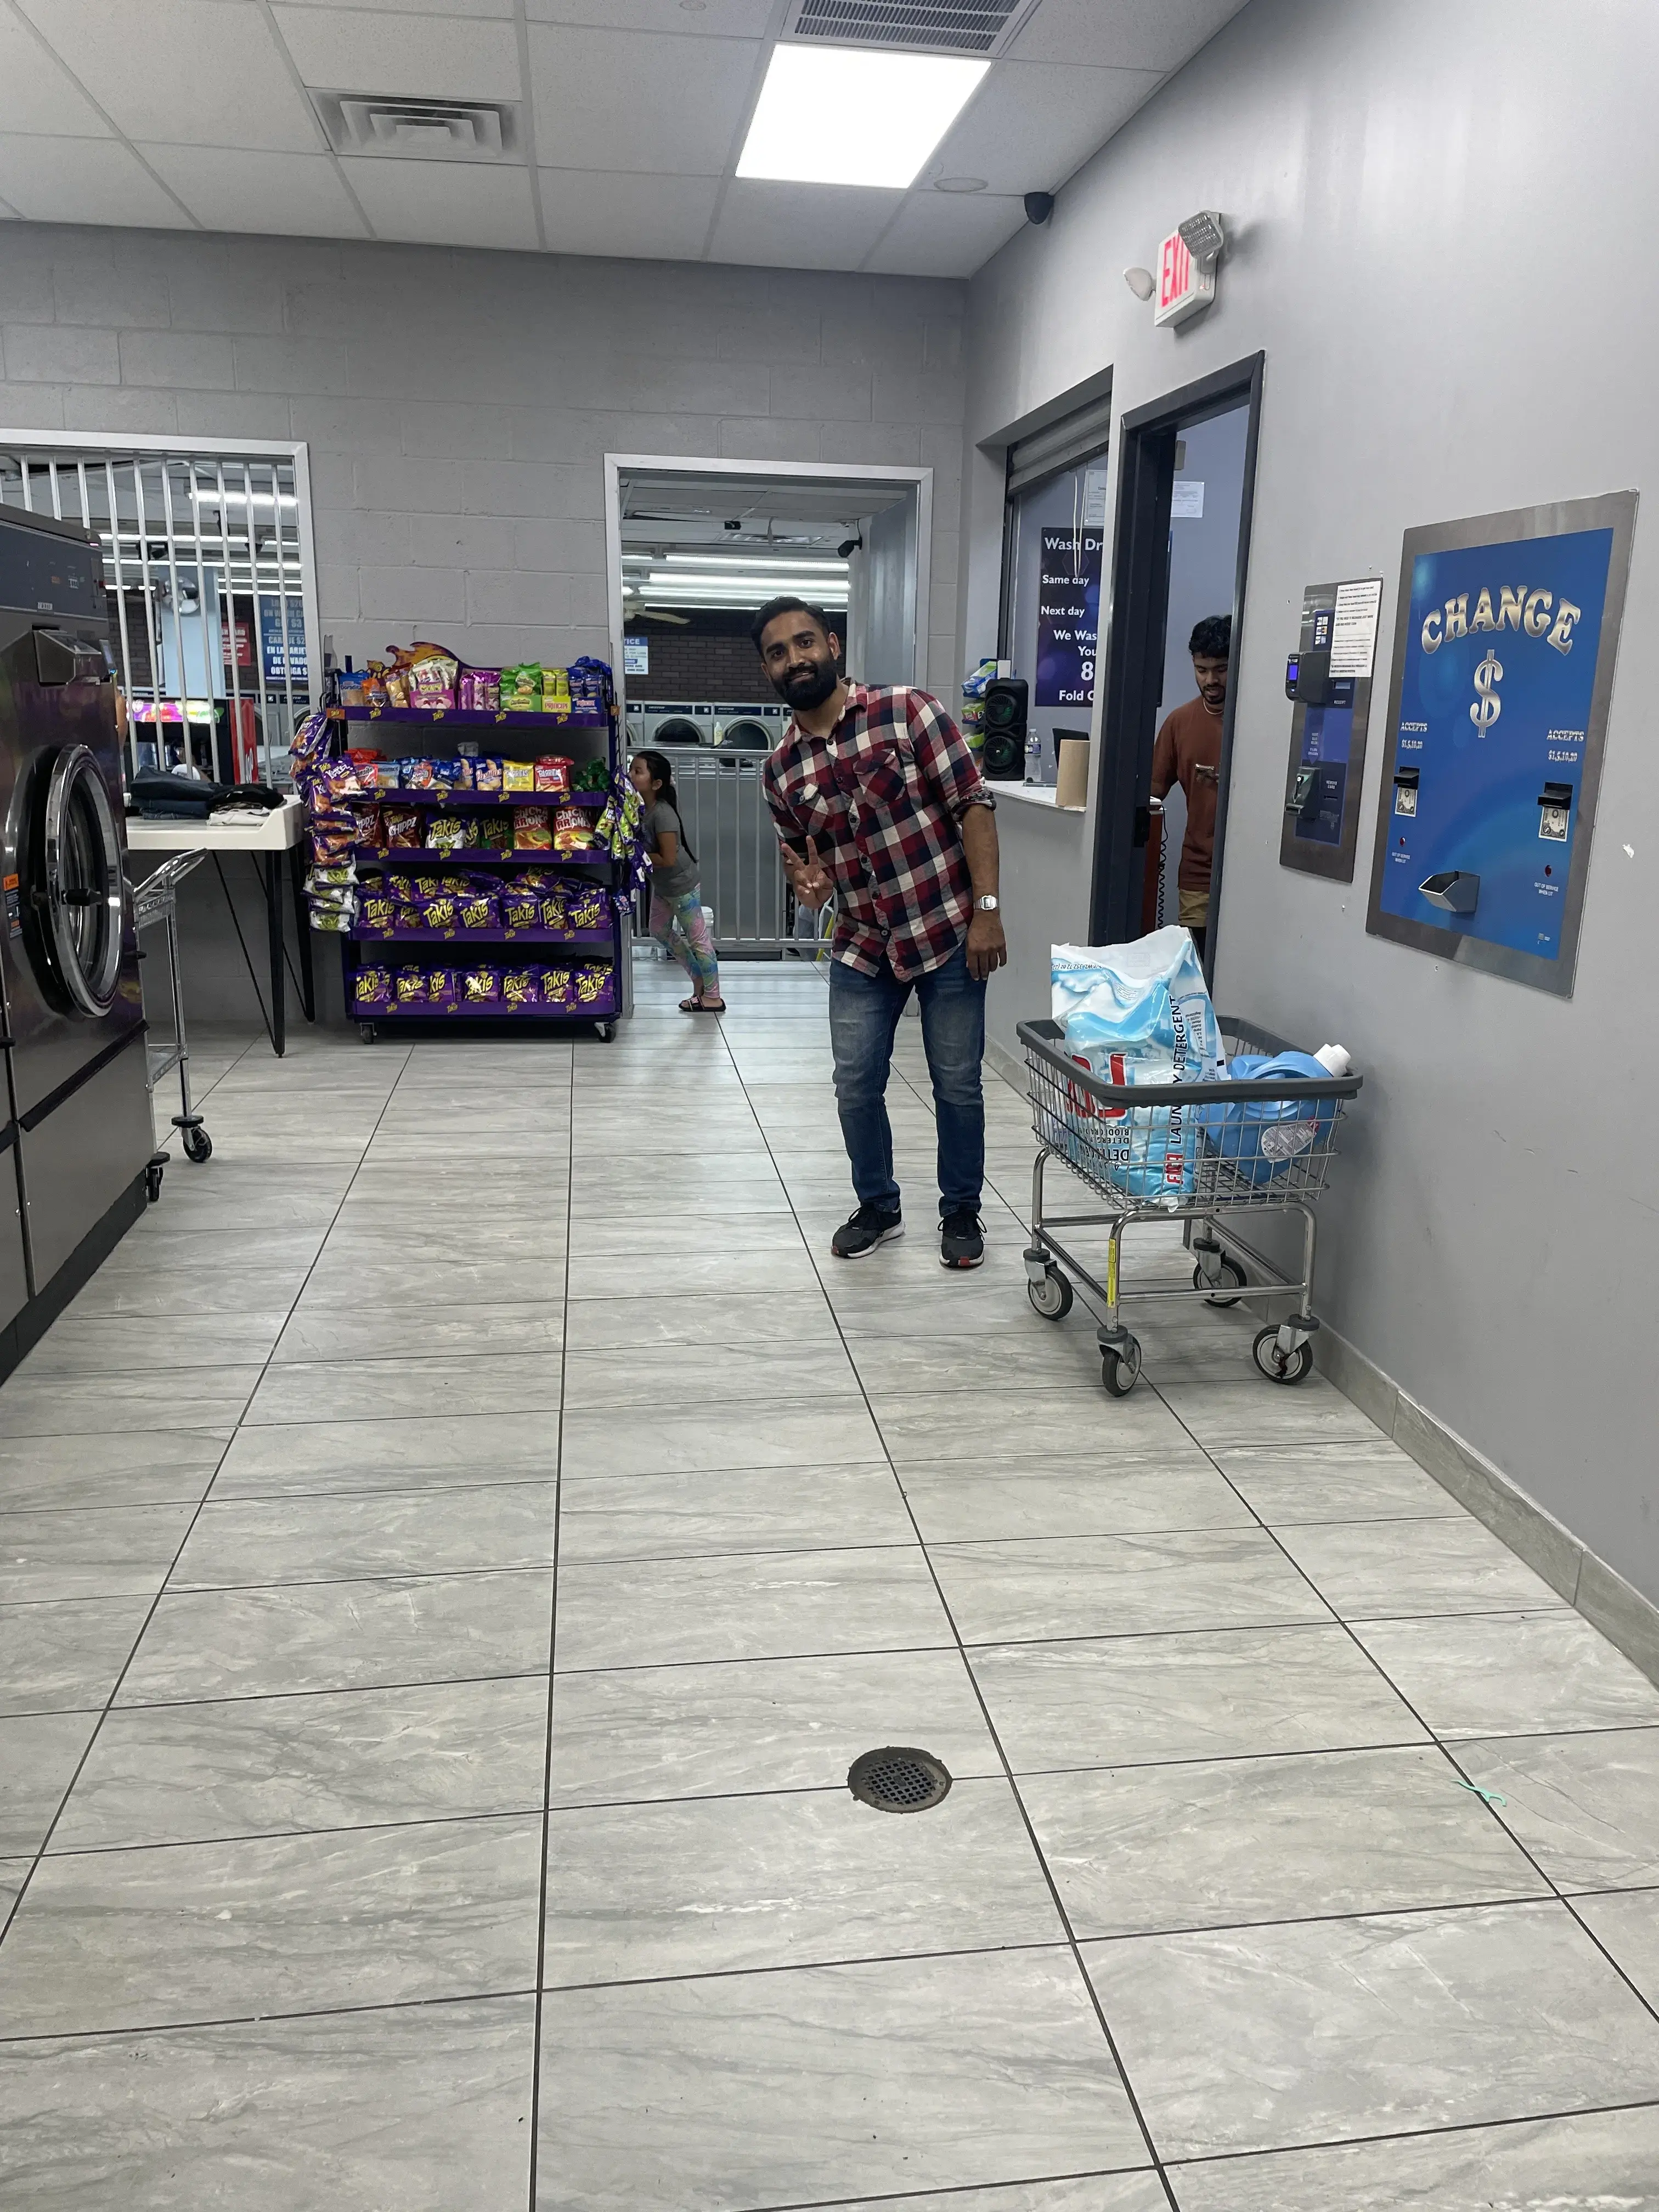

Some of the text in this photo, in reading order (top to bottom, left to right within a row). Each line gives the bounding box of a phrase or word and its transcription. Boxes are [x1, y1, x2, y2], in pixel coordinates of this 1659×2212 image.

[1161, 233, 1189, 308] EXIT
[1044, 537, 1080, 550] Wash
[1042, 574, 1090, 587] Same day
[1041, 606, 1085, 618] Next day
[1421, 585, 1581, 656] CHANGE
[1053, 630, 1071, 640] We
[267, 646, 275, 654] EN
[1059, 690, 1084, 701] Fold
[1400, 721, 1427, 732] ACCEPTS
[1547, 729, 1584, 742] ACCEPTS
[430, 819, 462, 840] Takis
[364, 899, 395, 920] Takis
[424, 903, 454, 928] Takis
[460, 902, 488, 928] Takis
[505, 905, 535, 925] Takis
[569, 903, 600, 928] Takis
[540, 972, 570, 994] Takis
[576, 975, 606, 996] Takis
[1169, 995, 1188, 1071] DETERGENT
[1170, 1074, 1182, 1144] LAUNY
